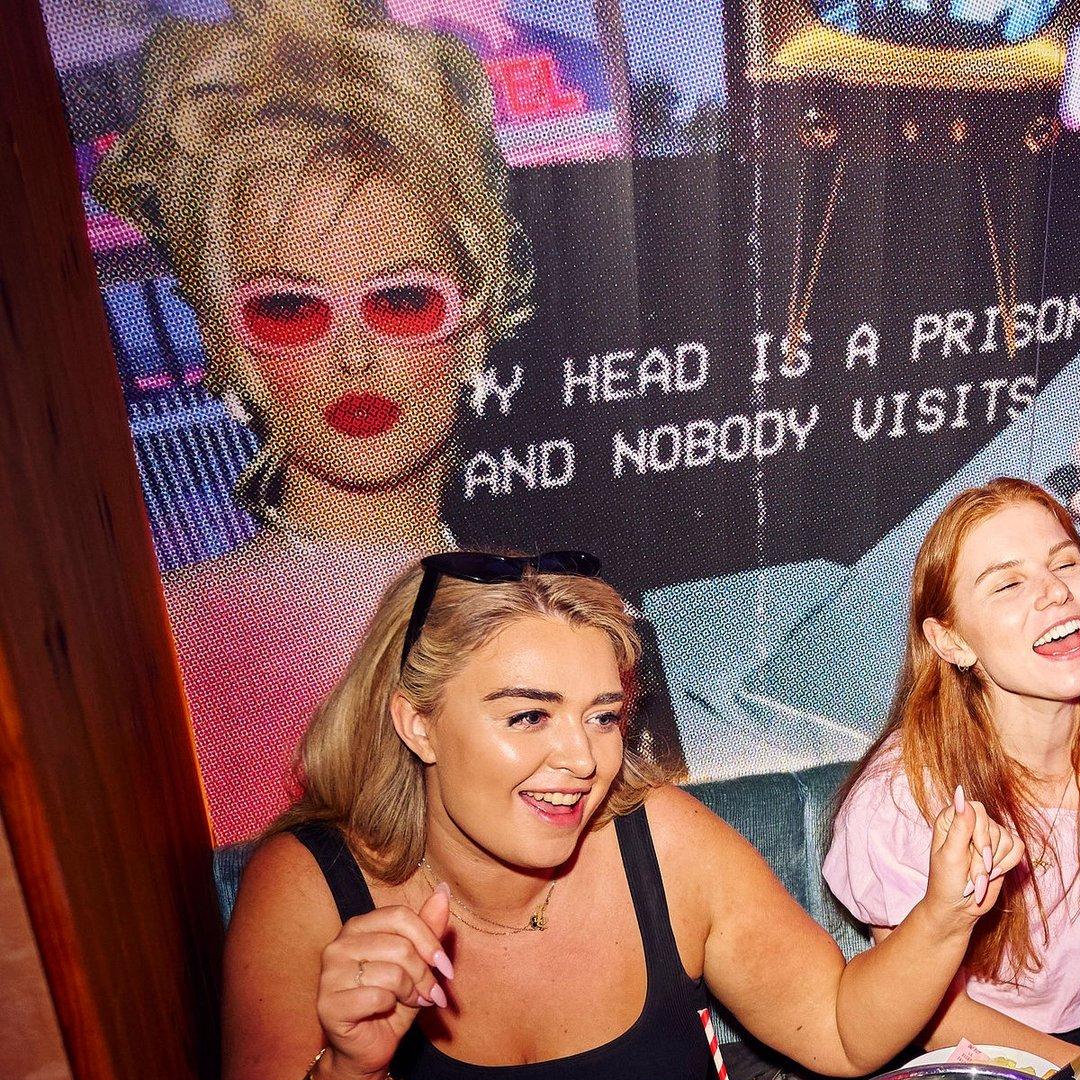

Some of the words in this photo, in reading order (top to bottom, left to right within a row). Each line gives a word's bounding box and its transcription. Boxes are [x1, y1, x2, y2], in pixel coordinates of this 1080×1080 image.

[563, 341, 709, 406] HEAD
[750, 329, 813, 384] IS
[846, 322, 880, 371] A
[463, 438, 576, 499] AND
[612, 404, 820, 478] NOBODY
[853, 374, 1037, 441] VISITS
